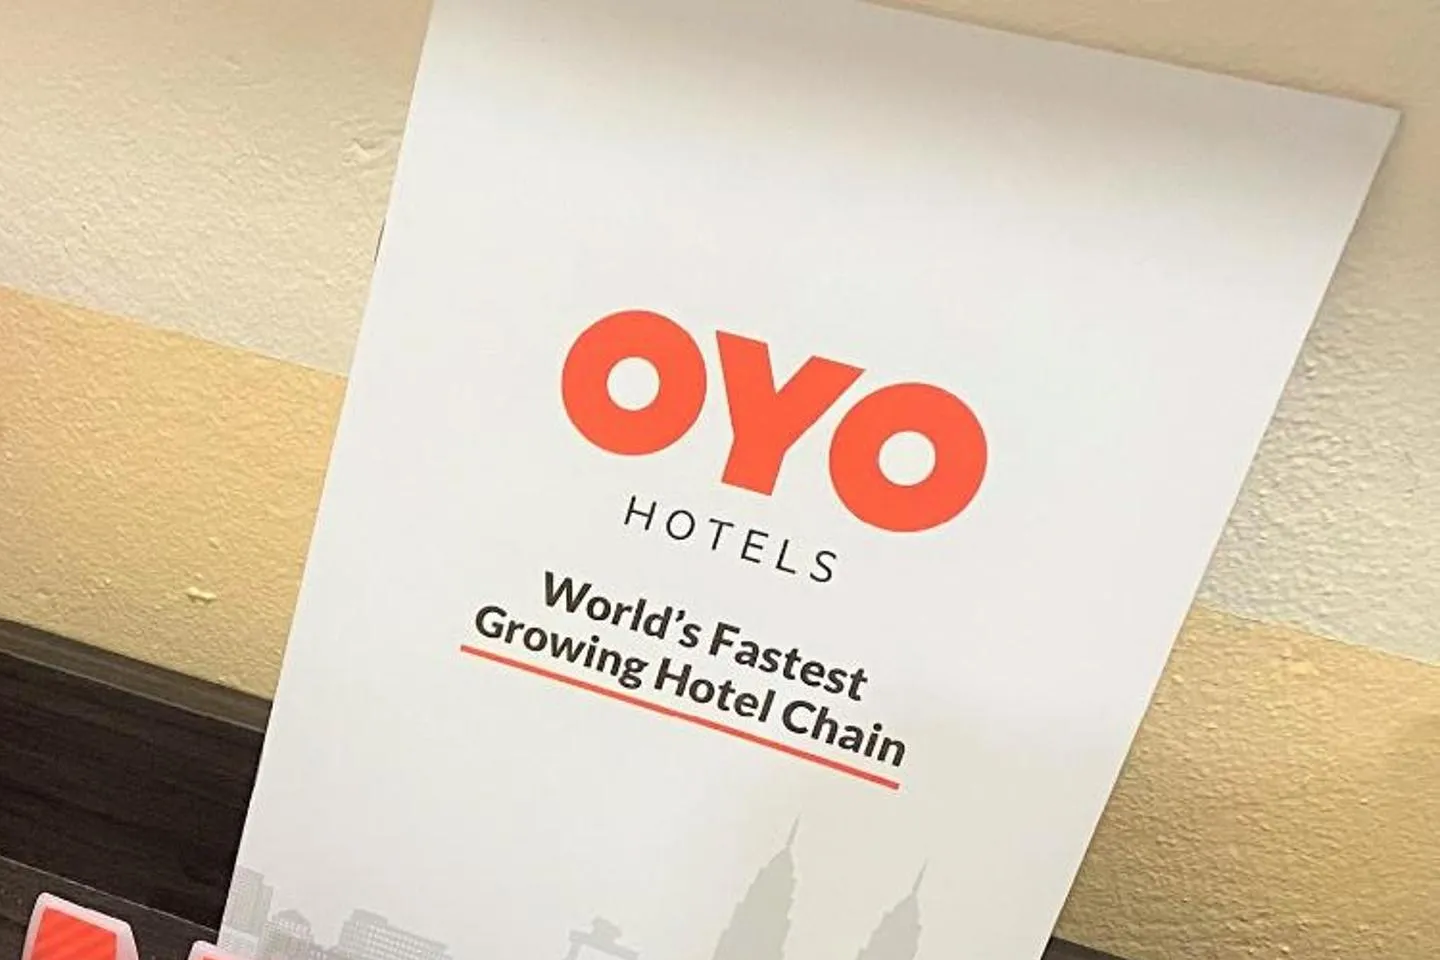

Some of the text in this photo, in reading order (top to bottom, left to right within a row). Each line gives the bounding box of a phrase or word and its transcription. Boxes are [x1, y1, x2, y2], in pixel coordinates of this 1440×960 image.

[561, 309, 987, 532] OYO
[623, 496, 839, 584] HOTELS
[474, 605, 907, 768] Growing Hotel Chain
[543, 571, 869, 701] World's Fastest
